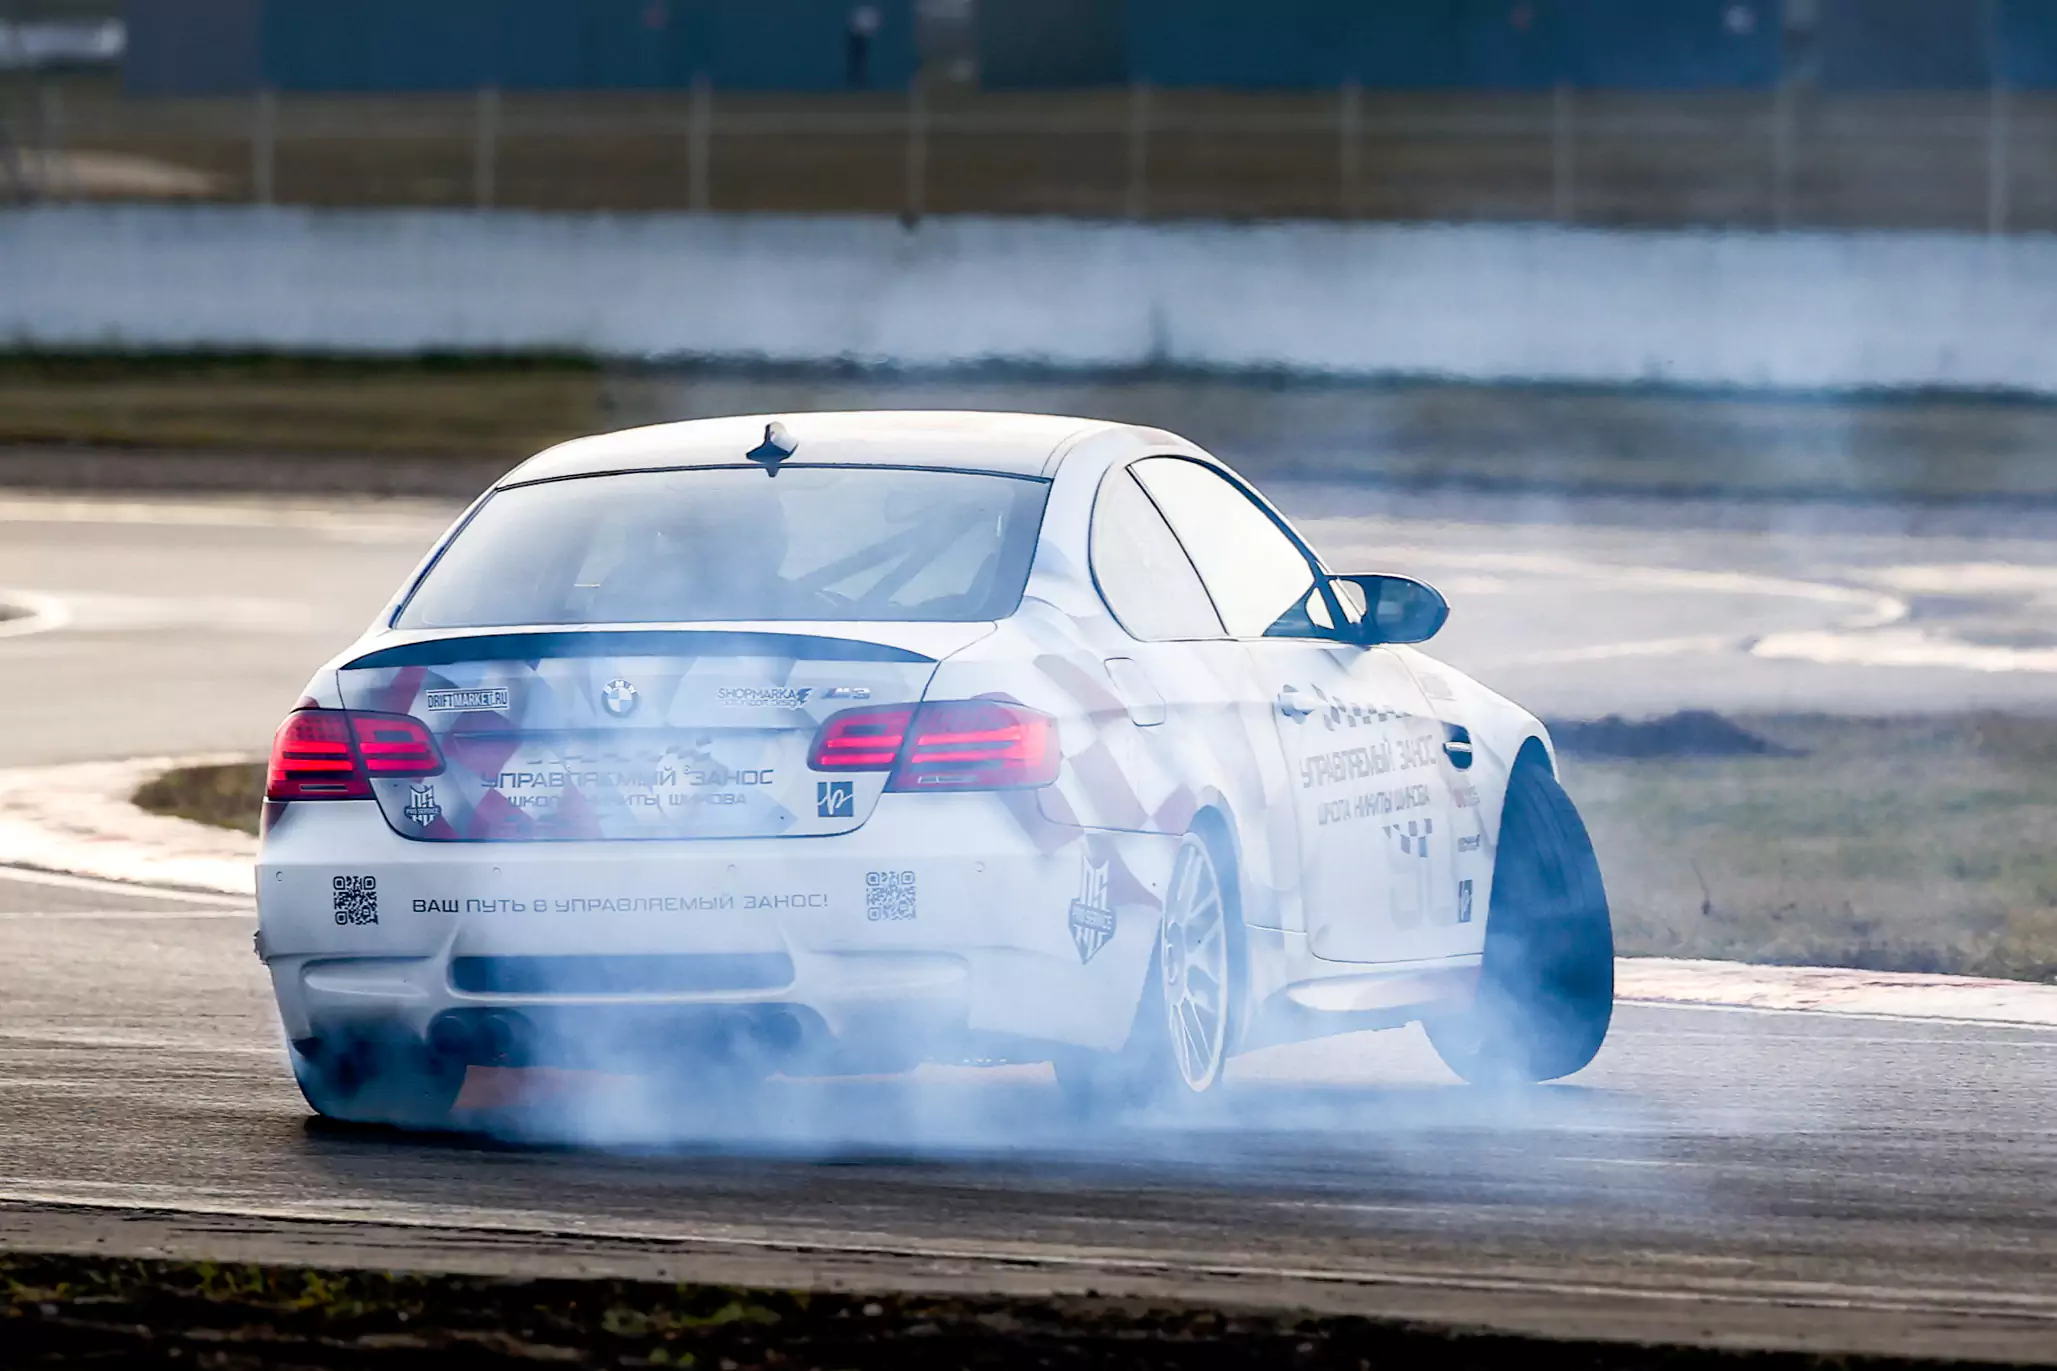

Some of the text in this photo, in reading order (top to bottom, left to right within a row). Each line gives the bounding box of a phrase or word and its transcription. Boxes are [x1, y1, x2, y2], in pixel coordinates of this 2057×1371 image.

[427, 690, 508, 709] DRIFTMARKET.RU
[717, 687, 797, 699] SHOPMARKA
[687, 769, 774, 786] ЗАНОС
[413, 893, 828, 913] ВАШ ПУТЬ В УПРАВЛЯЕМЫЙ ЗАНОС!
